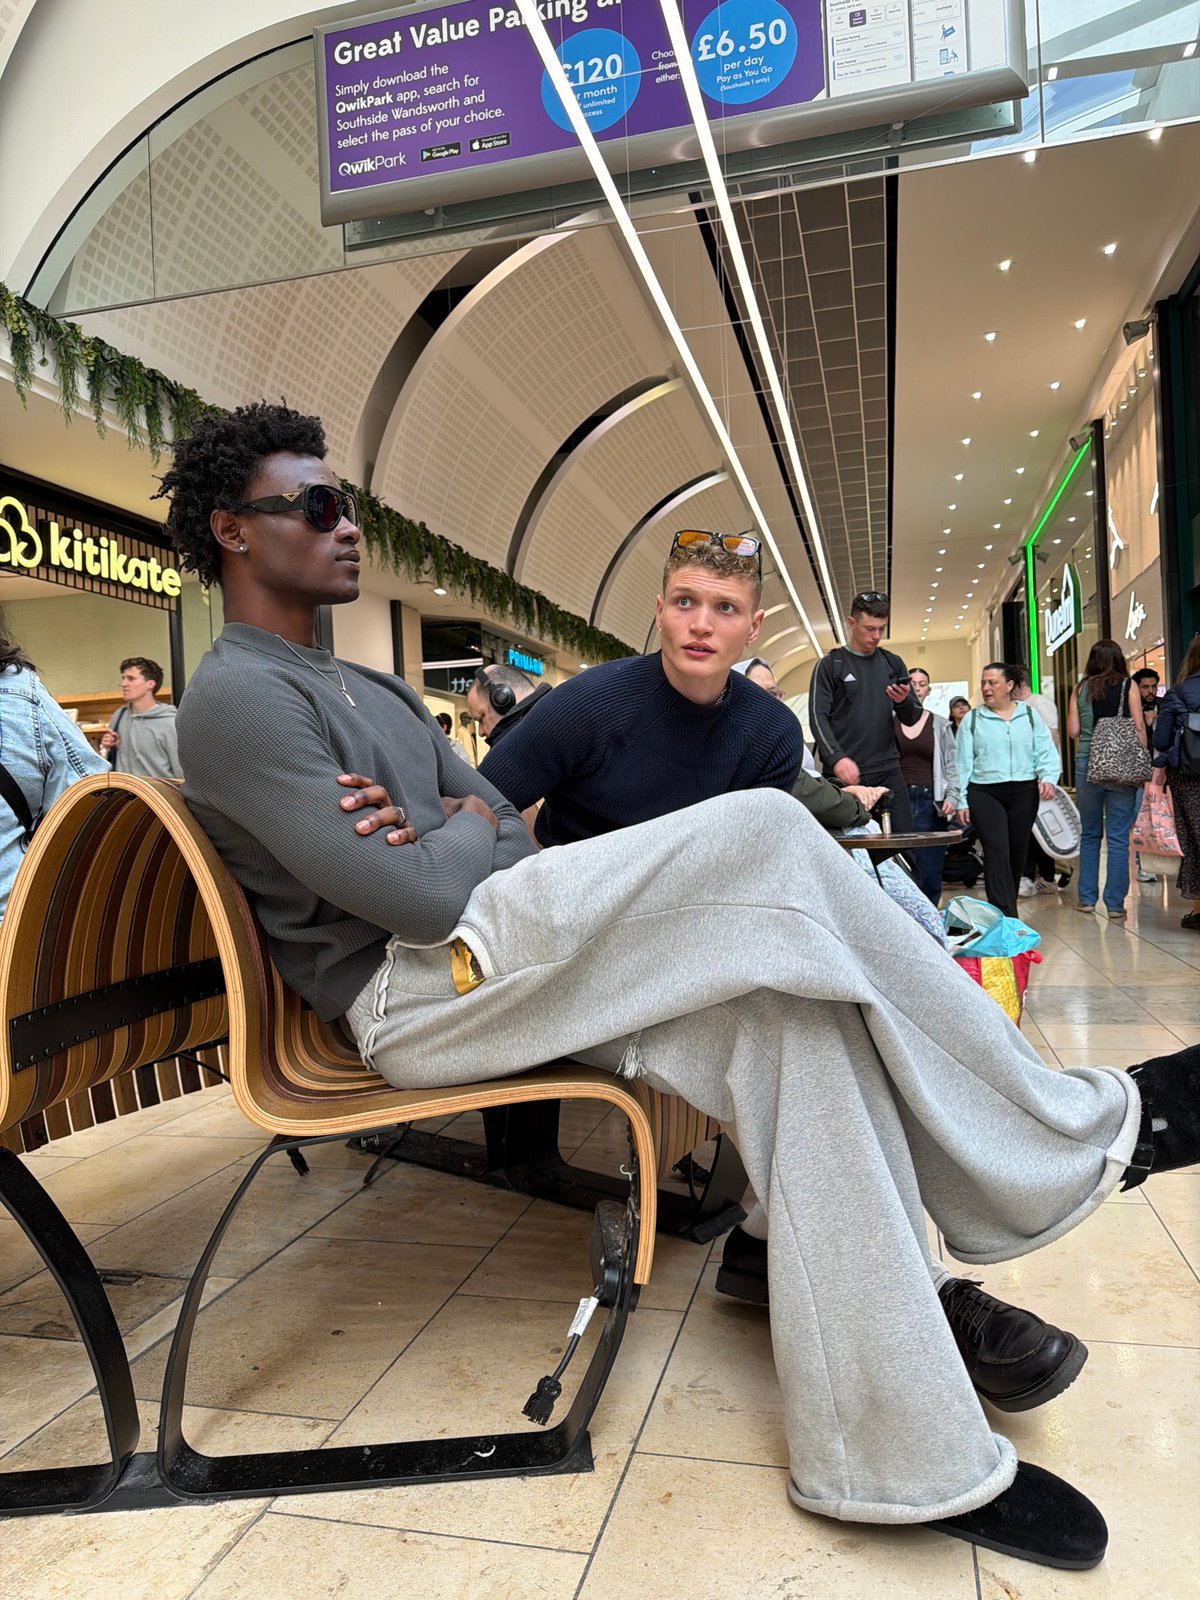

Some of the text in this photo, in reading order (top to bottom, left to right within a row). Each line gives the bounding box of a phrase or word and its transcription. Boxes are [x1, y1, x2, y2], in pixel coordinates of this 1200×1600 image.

[334, 31, 402, 65] Great
[410, 17, 480, 48] Value
[698, 18, 787, 62] £6.50
[716, 75, 730, 83] Pay
[744, 69, 759, 77] You
[761, 66, 773, 74] Go
[723, 56, 764, 74] per day
[335, 64, 449, 97] Simply download the
[720, 81, 750, 93] (Southside
[755, 76, 770, 85] only)
[335, 75, 480, 114] QwikPark app, search for
[583, 85, 617, 98] month
[336, 90, 485, 132] Southside Wandsworth and
[583, 97, 616, 109] unlimited
[585, 110, 603, 118] ccess
[337, 107, 505, 149] select the pass of your choice.
[431, 150, 449, 158] Google
[481, 139, 507, 149] App Store
[338, 152, 406, 177] QwikPark
[50, 522, 182, 597] kitikate
